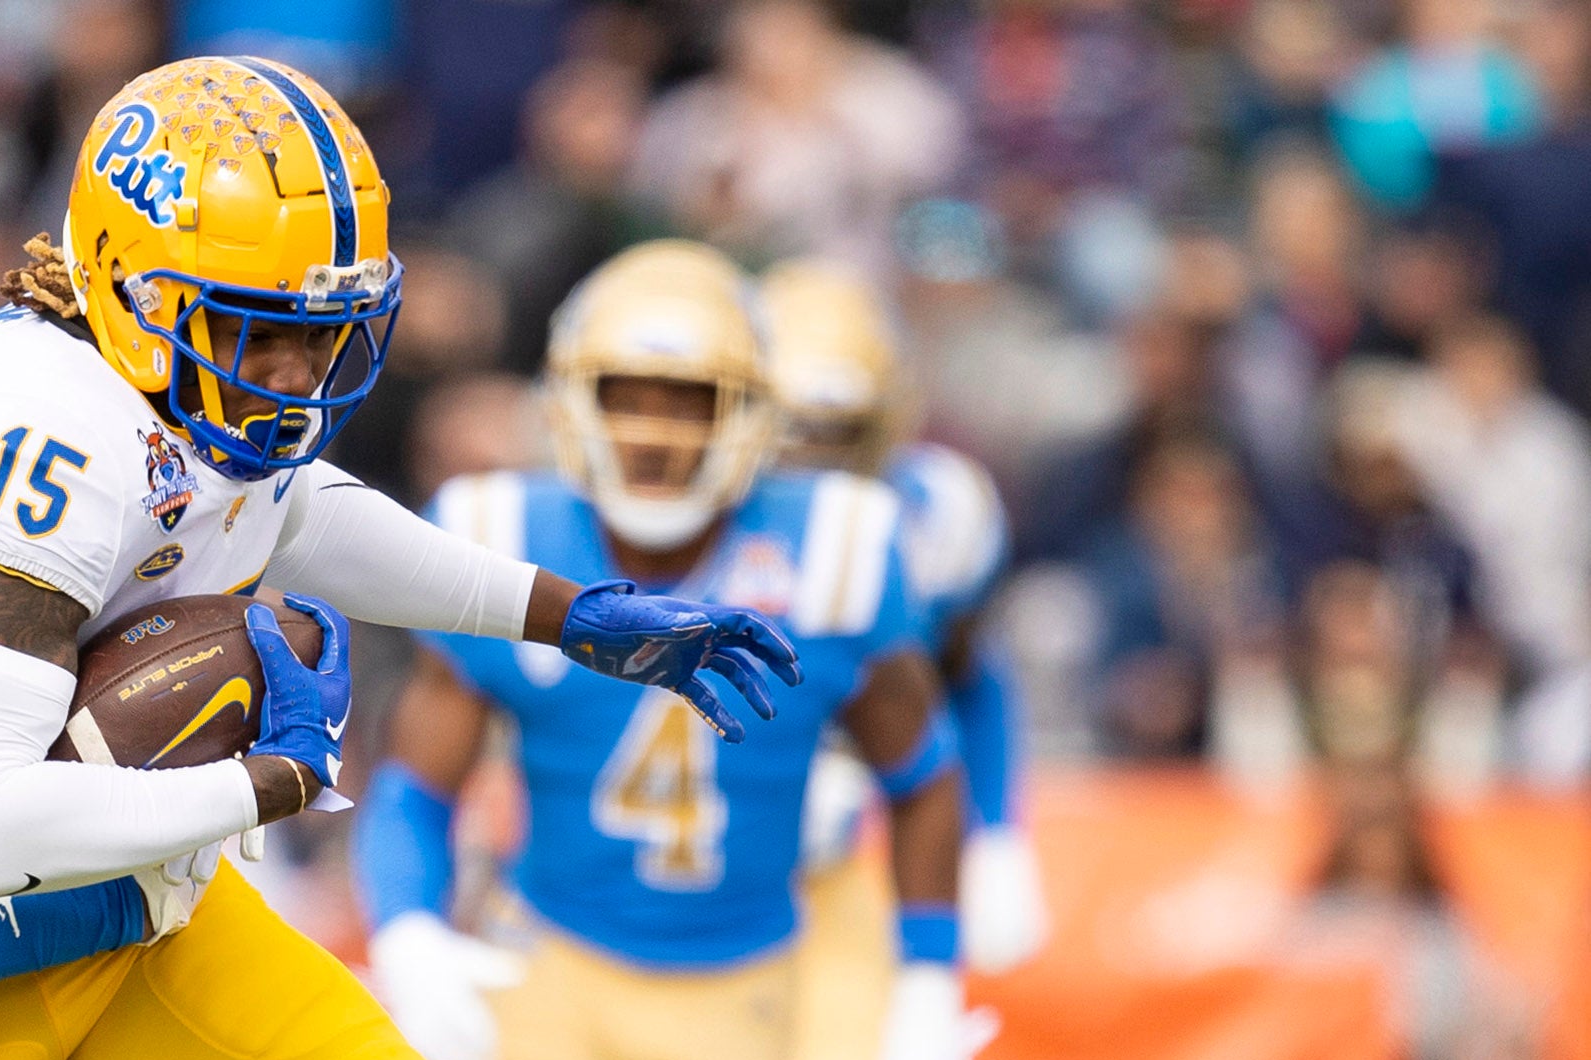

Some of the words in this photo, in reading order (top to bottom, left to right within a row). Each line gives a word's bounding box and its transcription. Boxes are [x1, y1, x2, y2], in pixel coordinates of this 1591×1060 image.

[94, 103, 186, 226] Pitt
[117, 668, 167, 701] ELITE
[167, 645, 224, 673] VAPOR
[590, 688, 730, 891] 4
